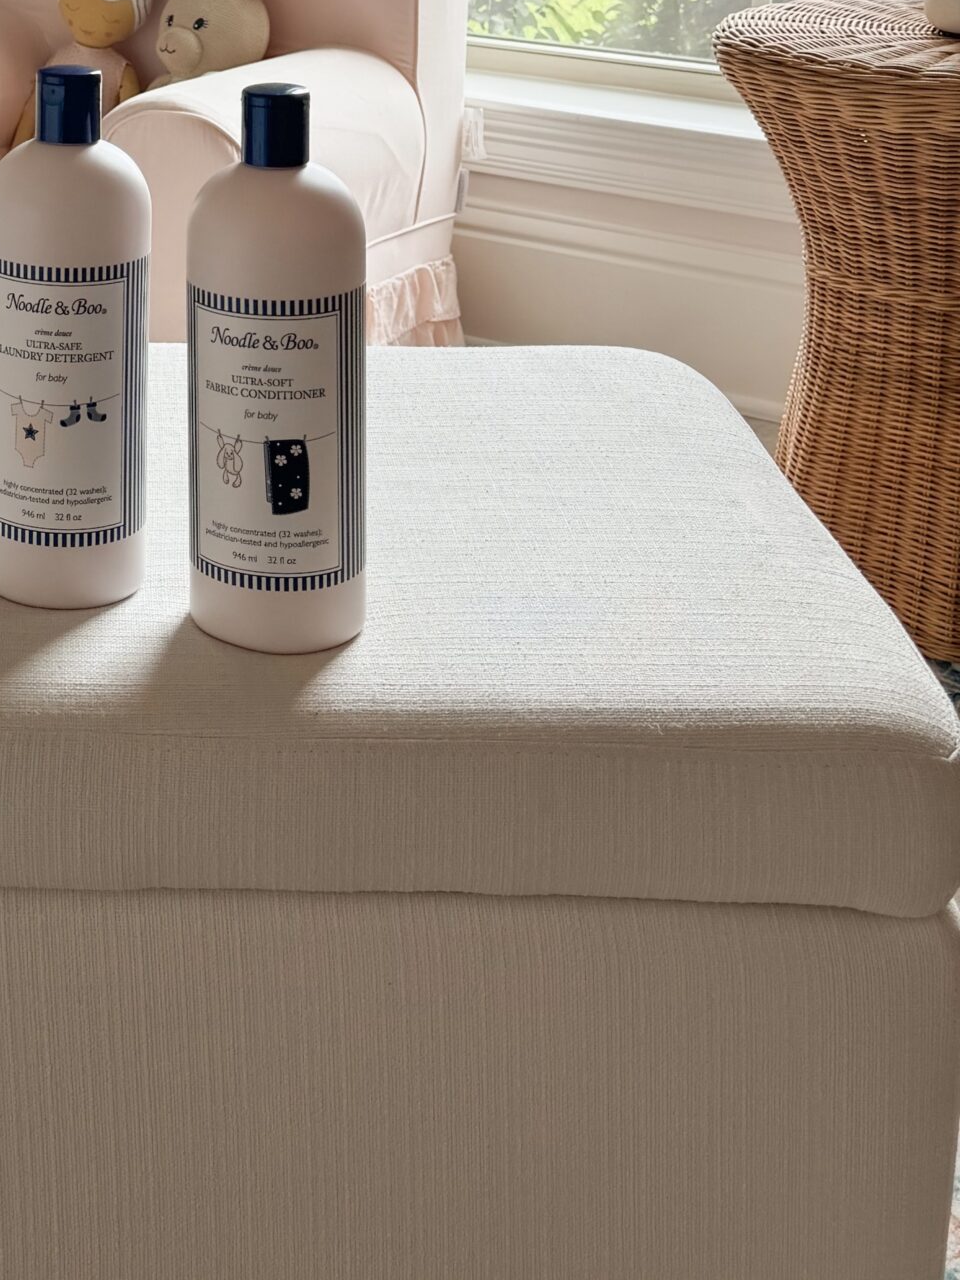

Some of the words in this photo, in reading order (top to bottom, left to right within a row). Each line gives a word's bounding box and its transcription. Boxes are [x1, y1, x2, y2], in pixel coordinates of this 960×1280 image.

[6, 292, 52, 314] Noodle
[54, 301, 70, 315] &
[211, 326, 259, 349] Noodle
[262, 335, 279, 350] &
[26, 339, 83, 351] ULTRA-SAFE
[0, 344, 42, 361] LAUNDRY
[45, 350, 115, 363] DETERGENT
[35, 372, 46, 382] for
[48, 372, 68, 384] baby
[231, 375, 295, 387] ULTRA-SOFT
[205, 380, 239, 397] FABRIC
[240, 388, 326, 400] CONDITIONER
[244, 409, 255, 419] for
[257, 410, 279, 422] baby
[3, 479, 19, 491] highly
[20, 484, 64, 495] concentrated
[65, 487, 77, 497] (32
[51, 497, 65, 505] and
[66, 495, 113, 507] hypoallergenic
[21, 509, 35, 519] 946
[36, 511, 46, 520] ml
[55, 513, 64, 521] 32
[66, 513, 71, 521] fl
[212, 520, 228, 532] highly
[230, 526, 276, 538] concentrated
[278, 529, 291, 539] (32
[264, 540, 278, 548] and
[279, 538, 329, 550] hypoallergenic
[232, 551, 247, 562] 946
[248, 554, 258, 563] ml
[267, 556, 278, 564] 32
[279, 555, 285, 564] fl
[286, 557, 297, 565] oz
